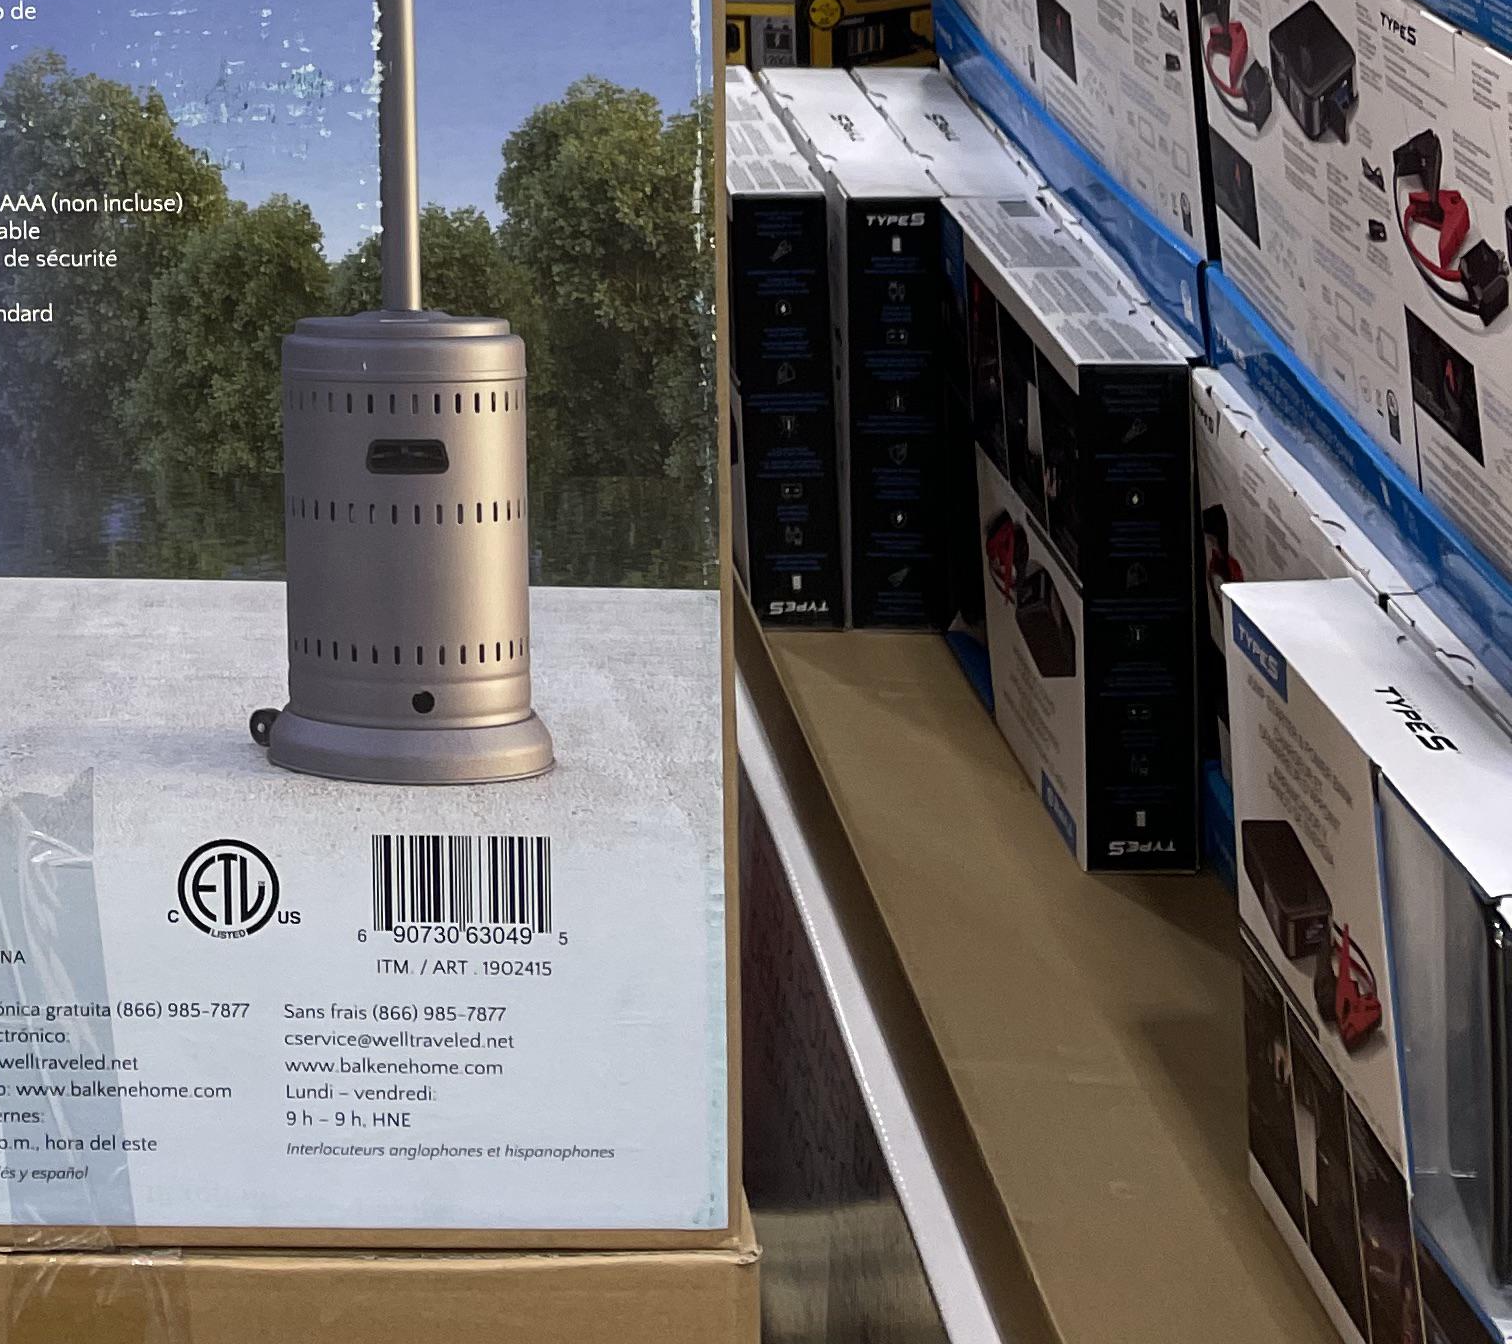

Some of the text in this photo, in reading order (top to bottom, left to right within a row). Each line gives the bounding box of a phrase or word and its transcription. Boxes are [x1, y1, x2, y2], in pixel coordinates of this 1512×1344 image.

[277, 910, 302, 925] US
[392, 925, 533, 946] 90730 63049
[283, 1001, 508, 1024] Sans frais (866) 985-7877
[284, 1030, 516, 1050] cservice@welltraveled.net
